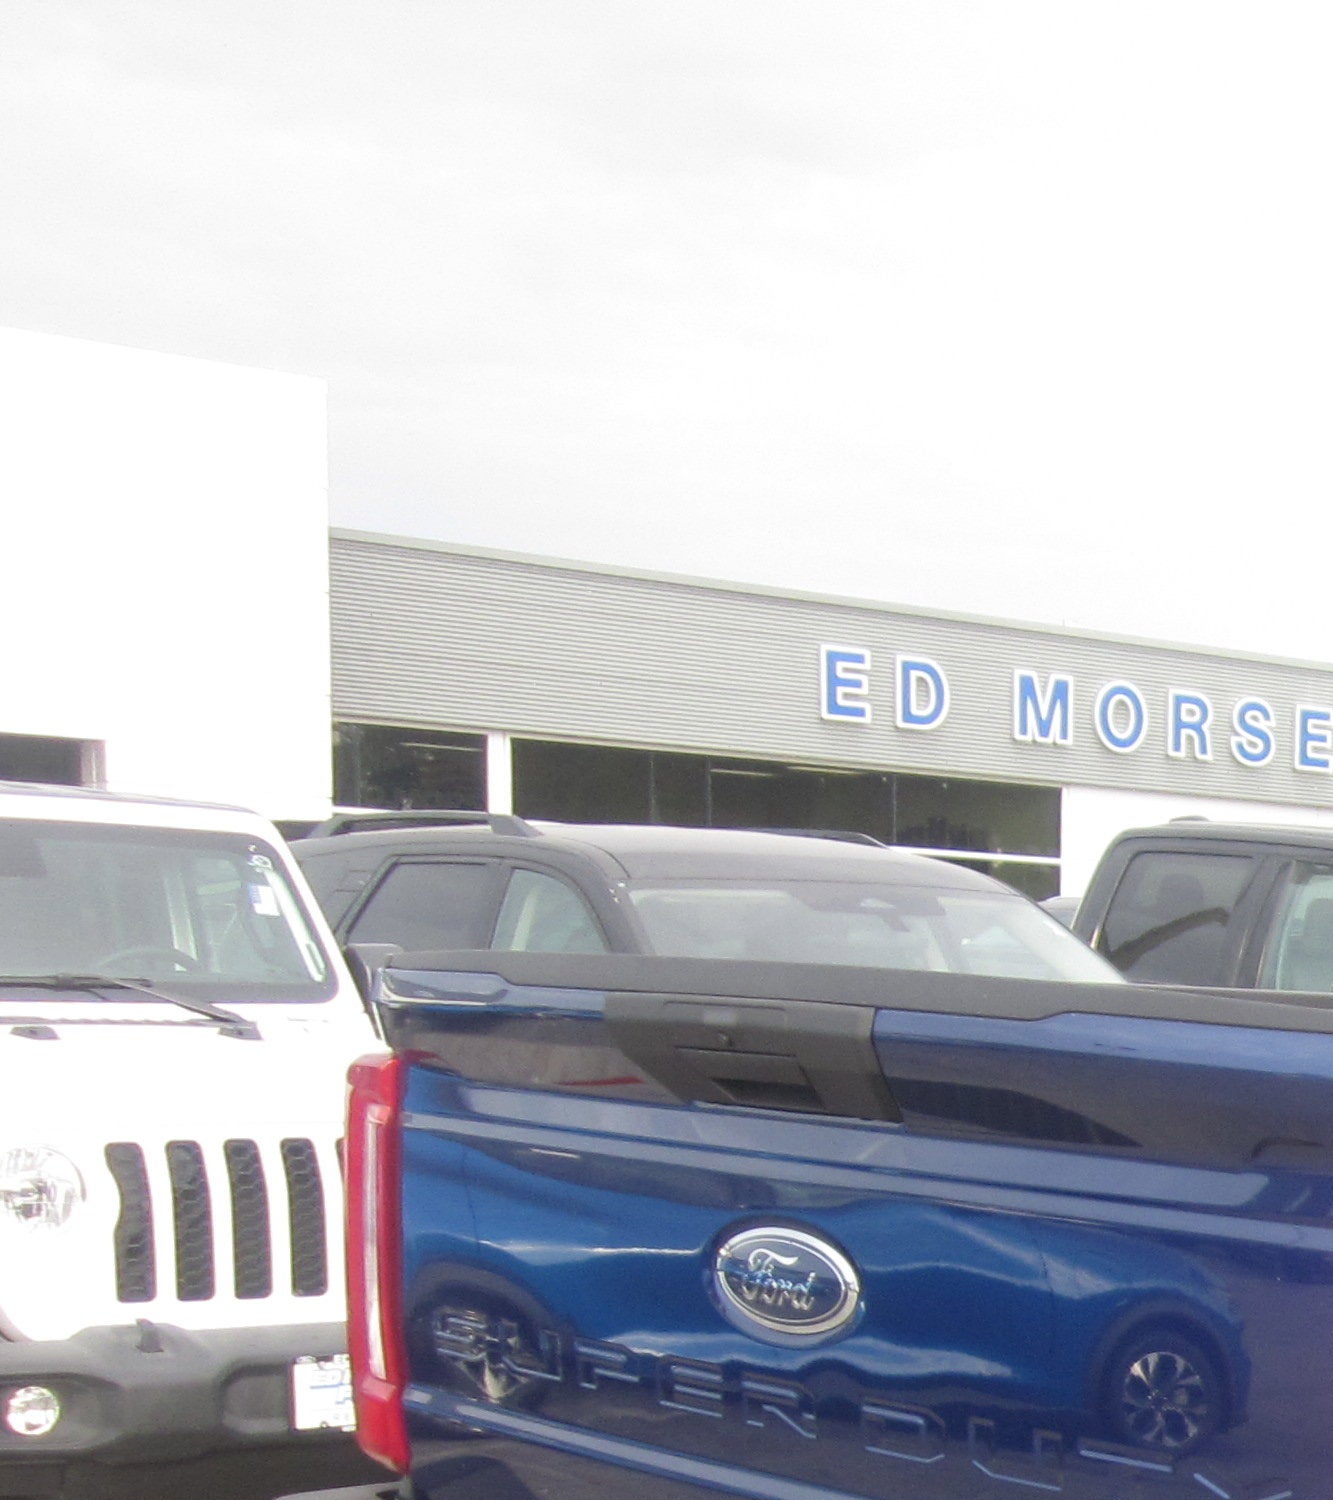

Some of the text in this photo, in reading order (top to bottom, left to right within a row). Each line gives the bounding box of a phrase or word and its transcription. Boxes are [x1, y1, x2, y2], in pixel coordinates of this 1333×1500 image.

[820, 644, 950, 730] ED
[740, 1247, 817, 1312] Ford
[434, 1306, 818, 1440] SUPER
